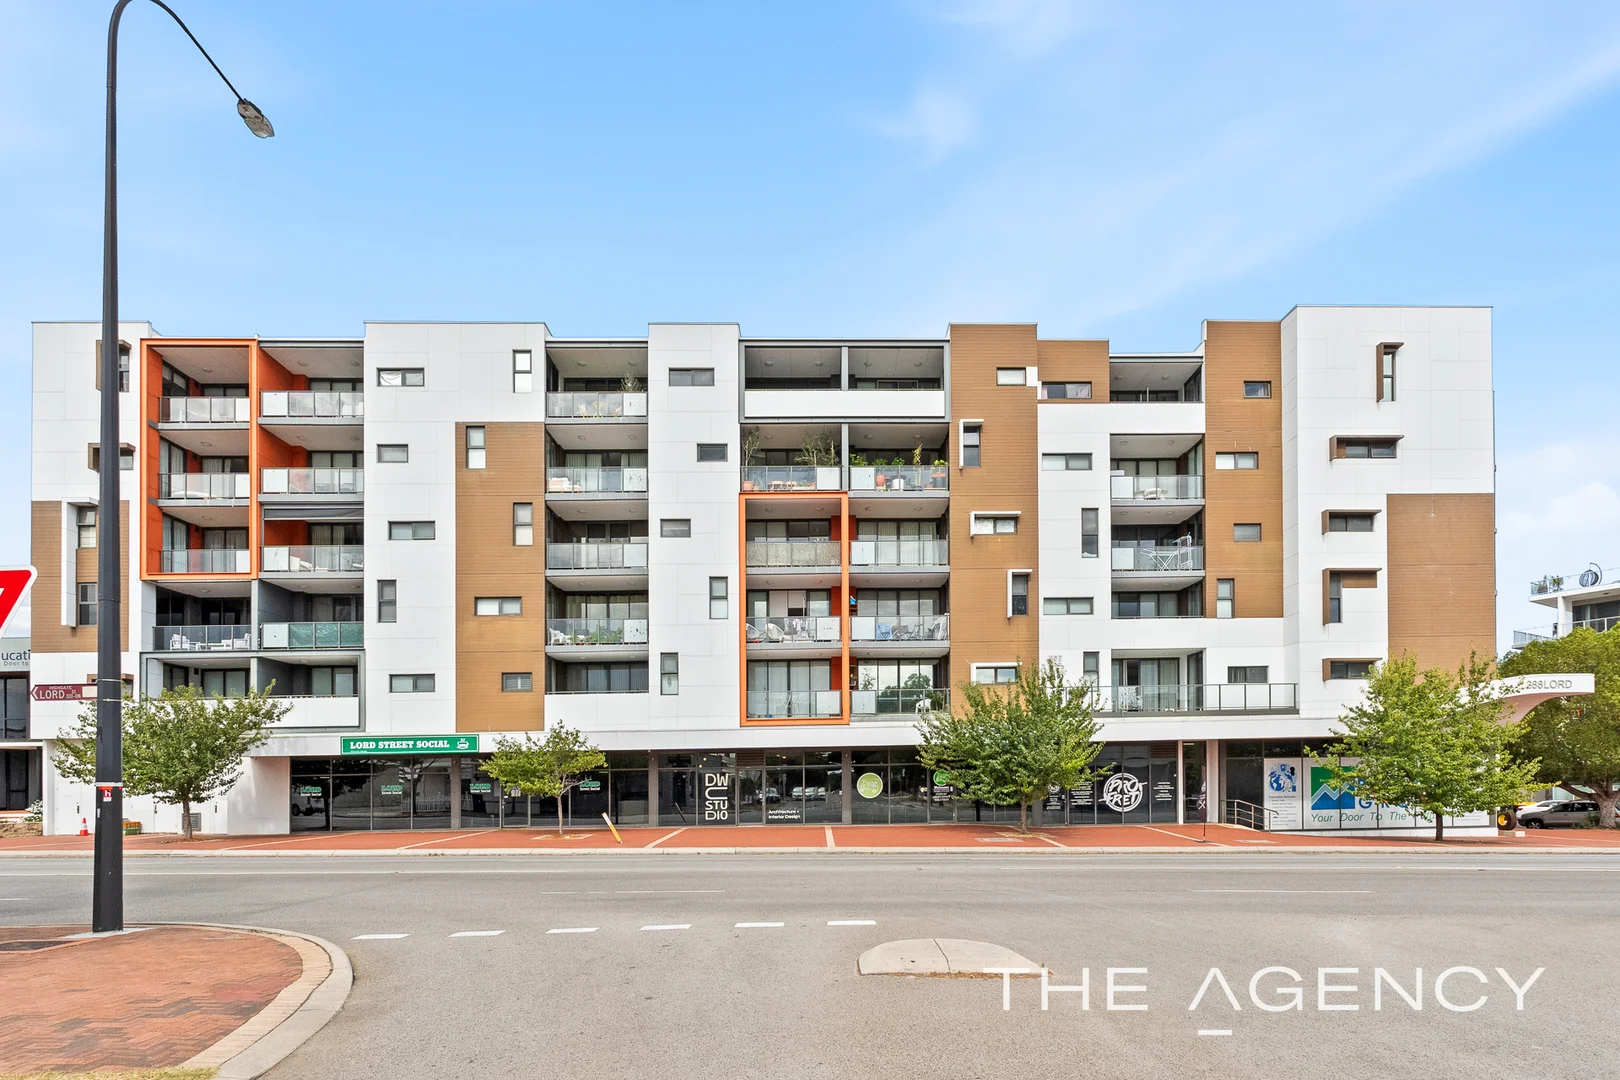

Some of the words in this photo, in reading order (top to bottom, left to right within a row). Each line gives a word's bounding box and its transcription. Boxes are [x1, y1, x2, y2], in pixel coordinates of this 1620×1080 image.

[40, 690, 65, 700] LORD
[705, 774, 728, 786] DW
[705, 801, 728, 810] STU
[1311, 814, 1332, 823] Your
[1341, 812, 1364, 822] Door
[1390, 812, 1407, 821] The
